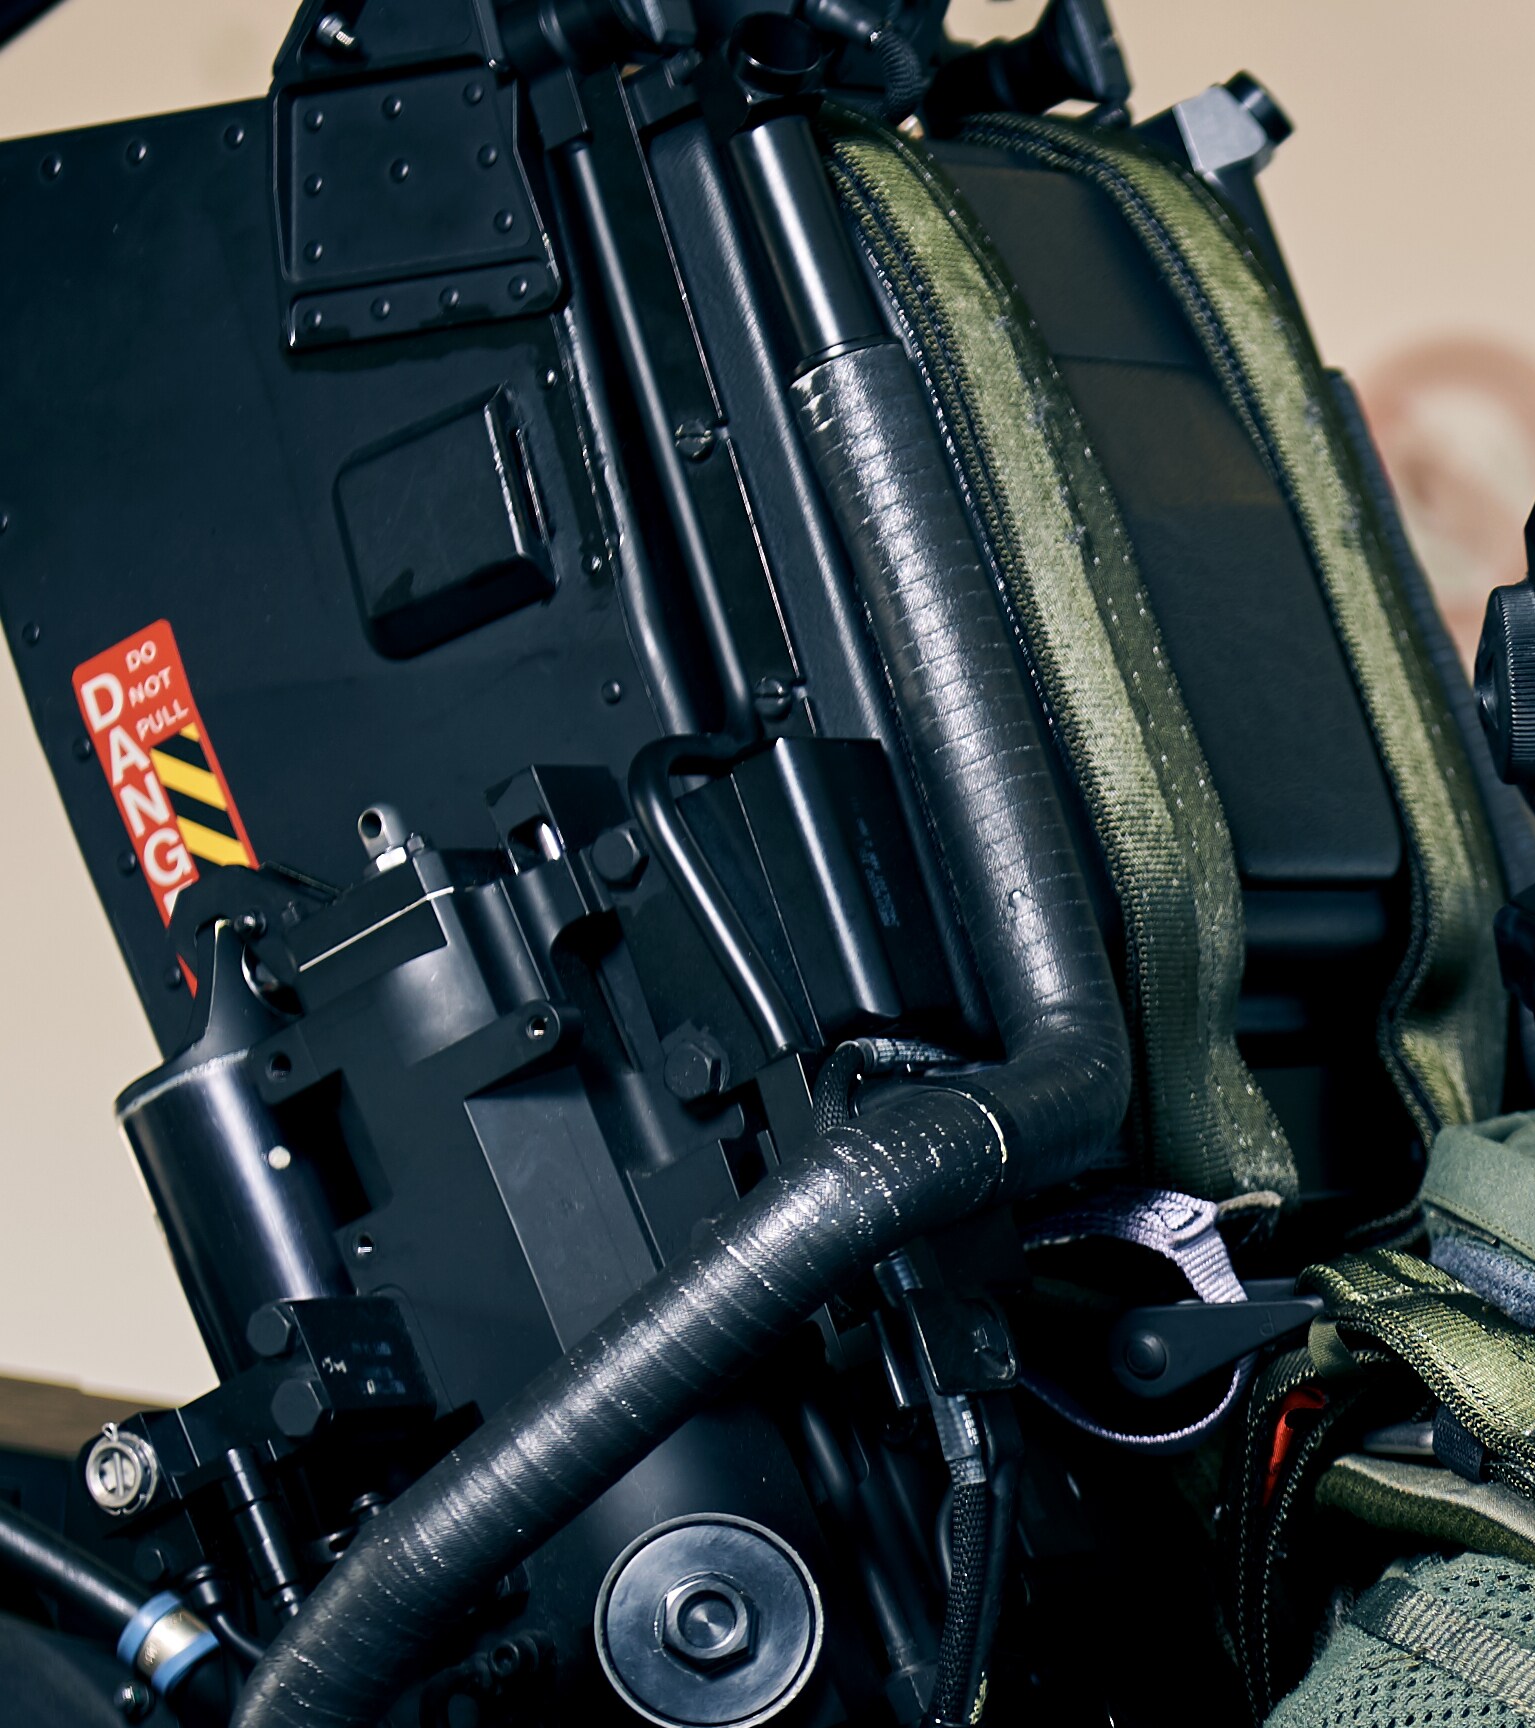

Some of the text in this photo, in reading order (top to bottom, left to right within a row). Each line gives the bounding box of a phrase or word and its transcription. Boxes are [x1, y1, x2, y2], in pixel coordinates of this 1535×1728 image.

[125, 640, 157, 673] DO
[128, 666, 171, 708] NOT
[135, 699, 190, 742] PULL
[80, 672, 196, 918] DANG
